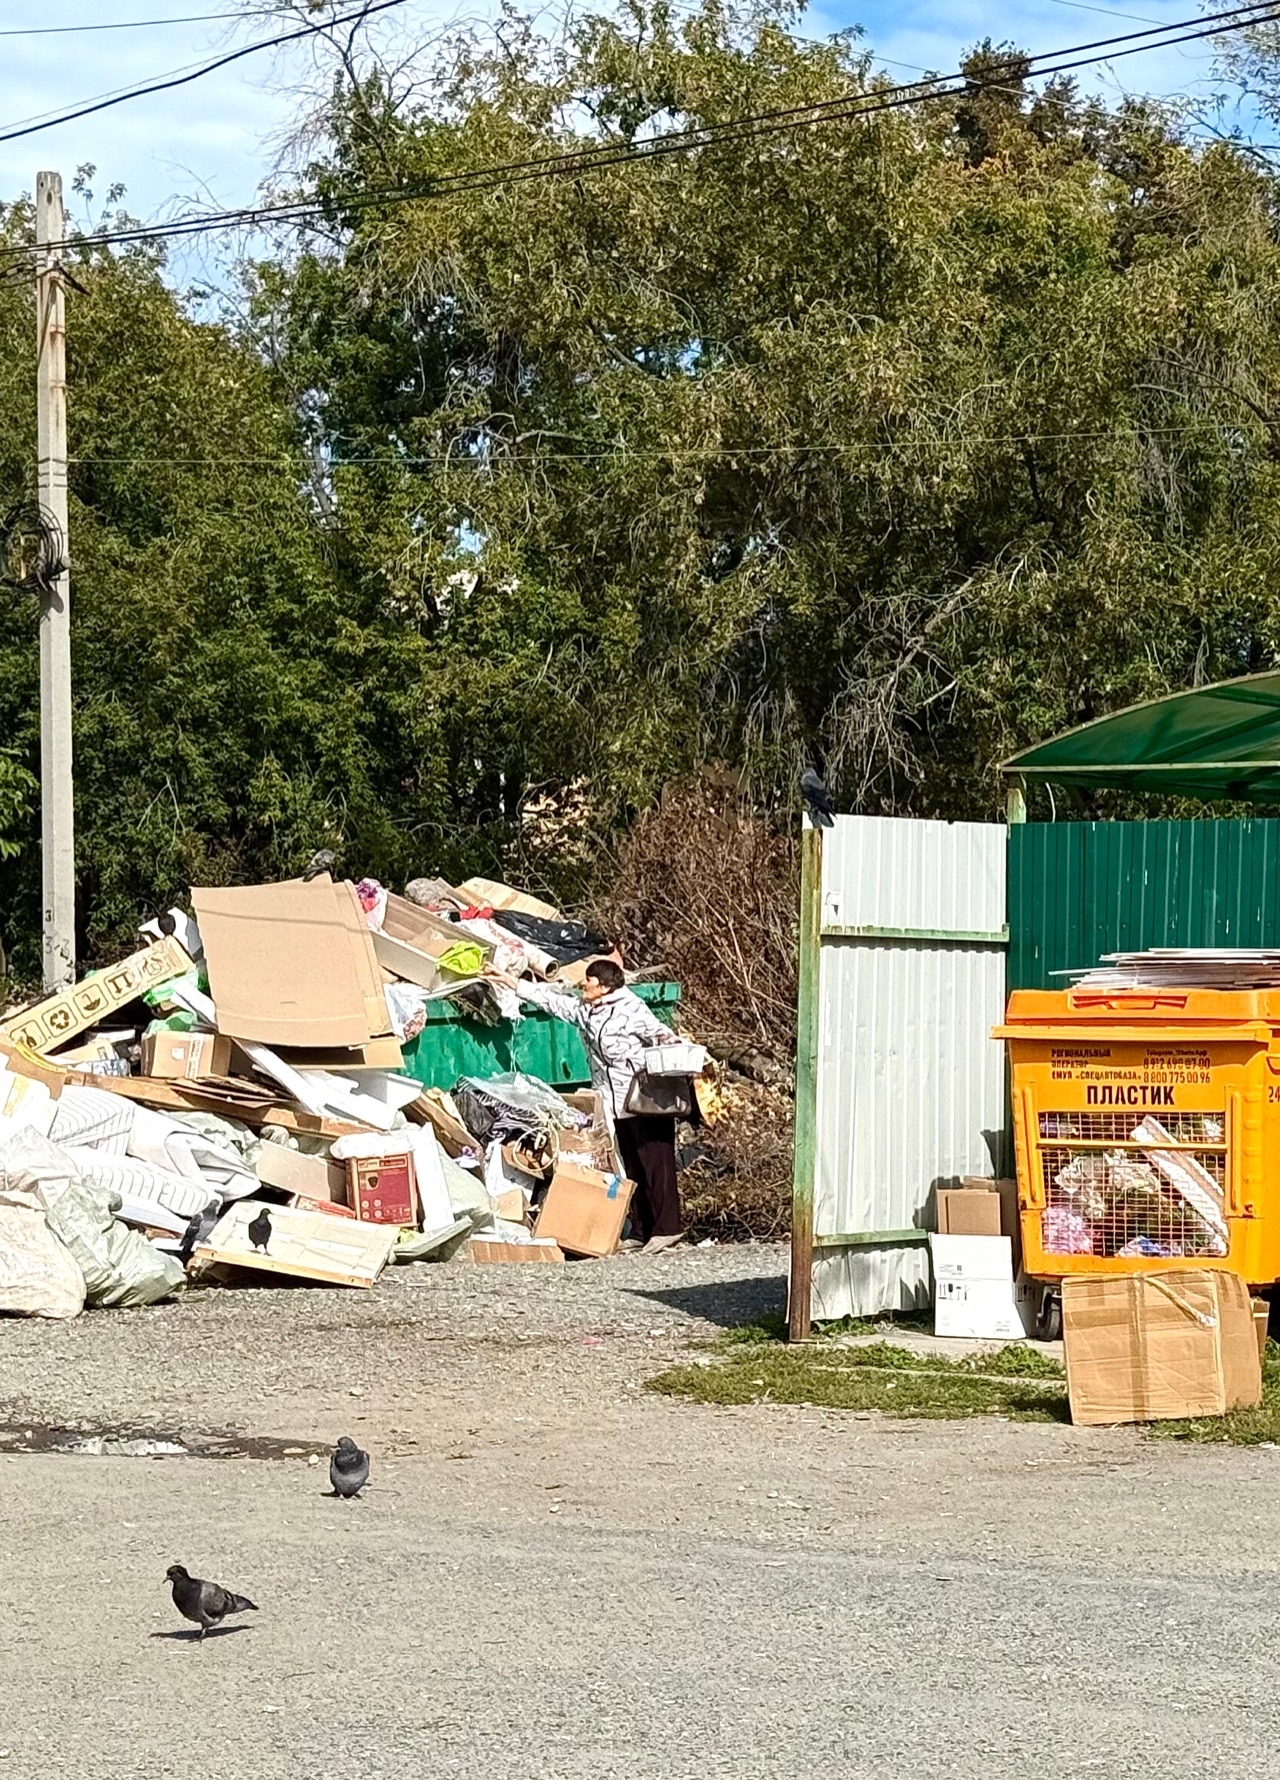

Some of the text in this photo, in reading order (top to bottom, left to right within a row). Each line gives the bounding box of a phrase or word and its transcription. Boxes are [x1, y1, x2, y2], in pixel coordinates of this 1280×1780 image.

[1143, 1071, 1211, 1083] 8 800 775 00 96
[1086, 1085, 1175, 1105] ПЛАСТИК
